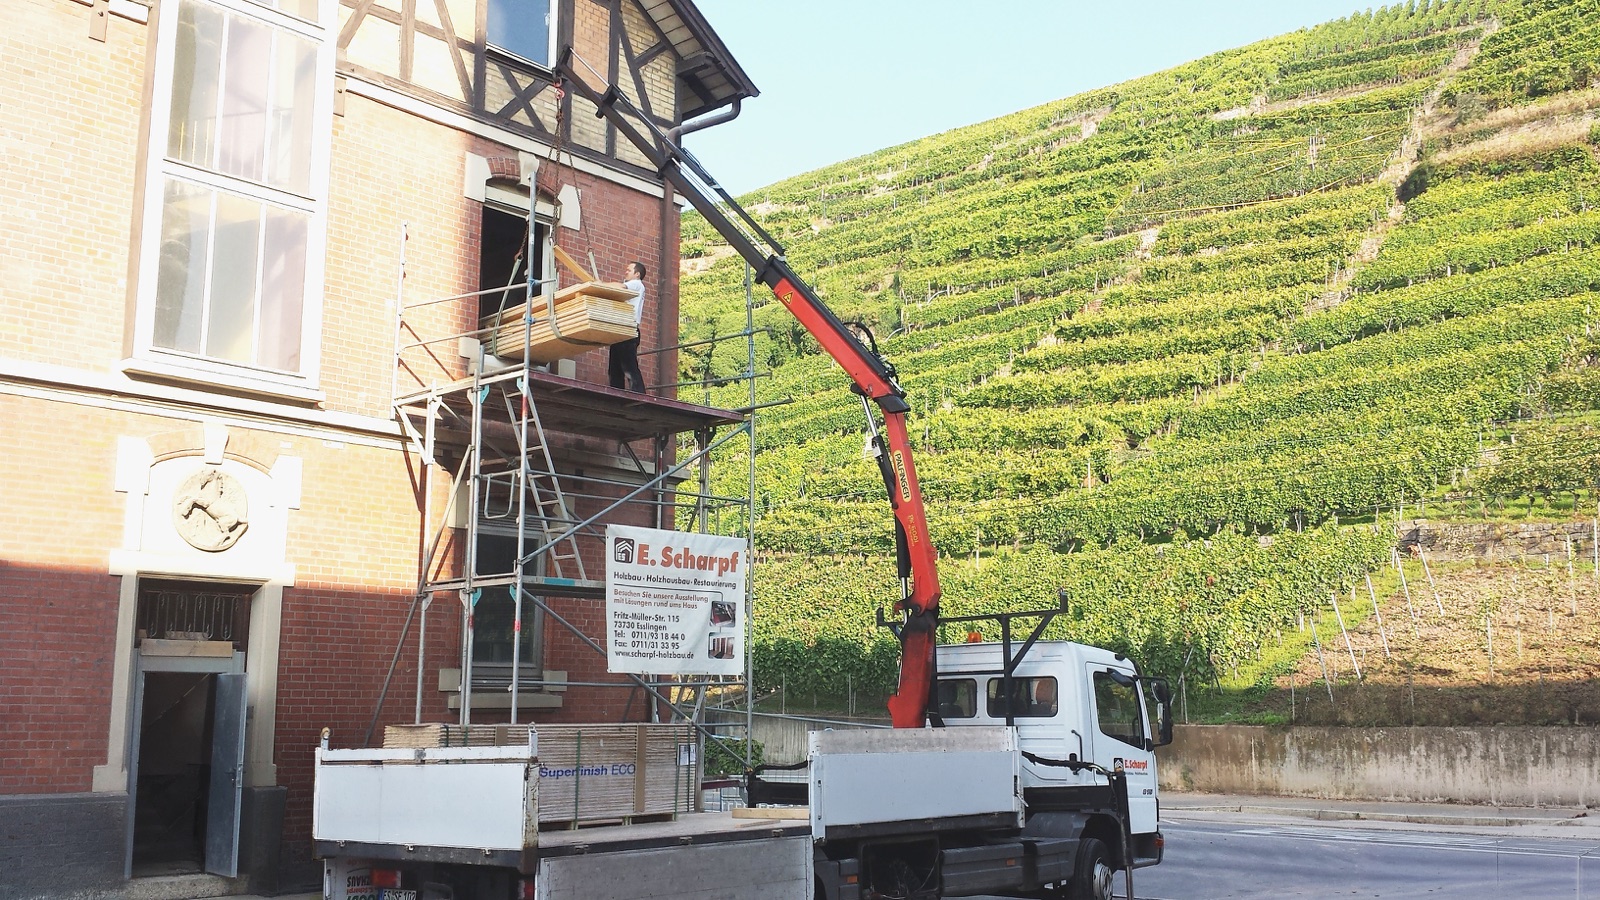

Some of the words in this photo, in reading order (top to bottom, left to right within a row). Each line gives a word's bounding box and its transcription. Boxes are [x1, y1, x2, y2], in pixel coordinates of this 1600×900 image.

[895, 454, 910, 499] PALFINGER
[637, 544, 657, 566] E.
[660, 546, 739, 577] Scharpf
[614, 572, 641, 581] Holzbau
[646, 575, 690, 584] Holzhausbau
[693, 580, 736, 589] Restaurierung
[614, 589, 640, 597] Besuchen
[675, 594, 708, 603] Ausstellung
[625, 598, 652, 607] Lösungen
[614, 612, 665, 622] Fritz-Müller-Str.
[637, 623, 666, 632] Esslingen
[632, 631, 658, 639] 0711/93
[615, 650, 694, 659] www.scharpf-holzbau.de
[540, 765, 608, 779] Superinish
[612, 764, 636, 775] ECO
